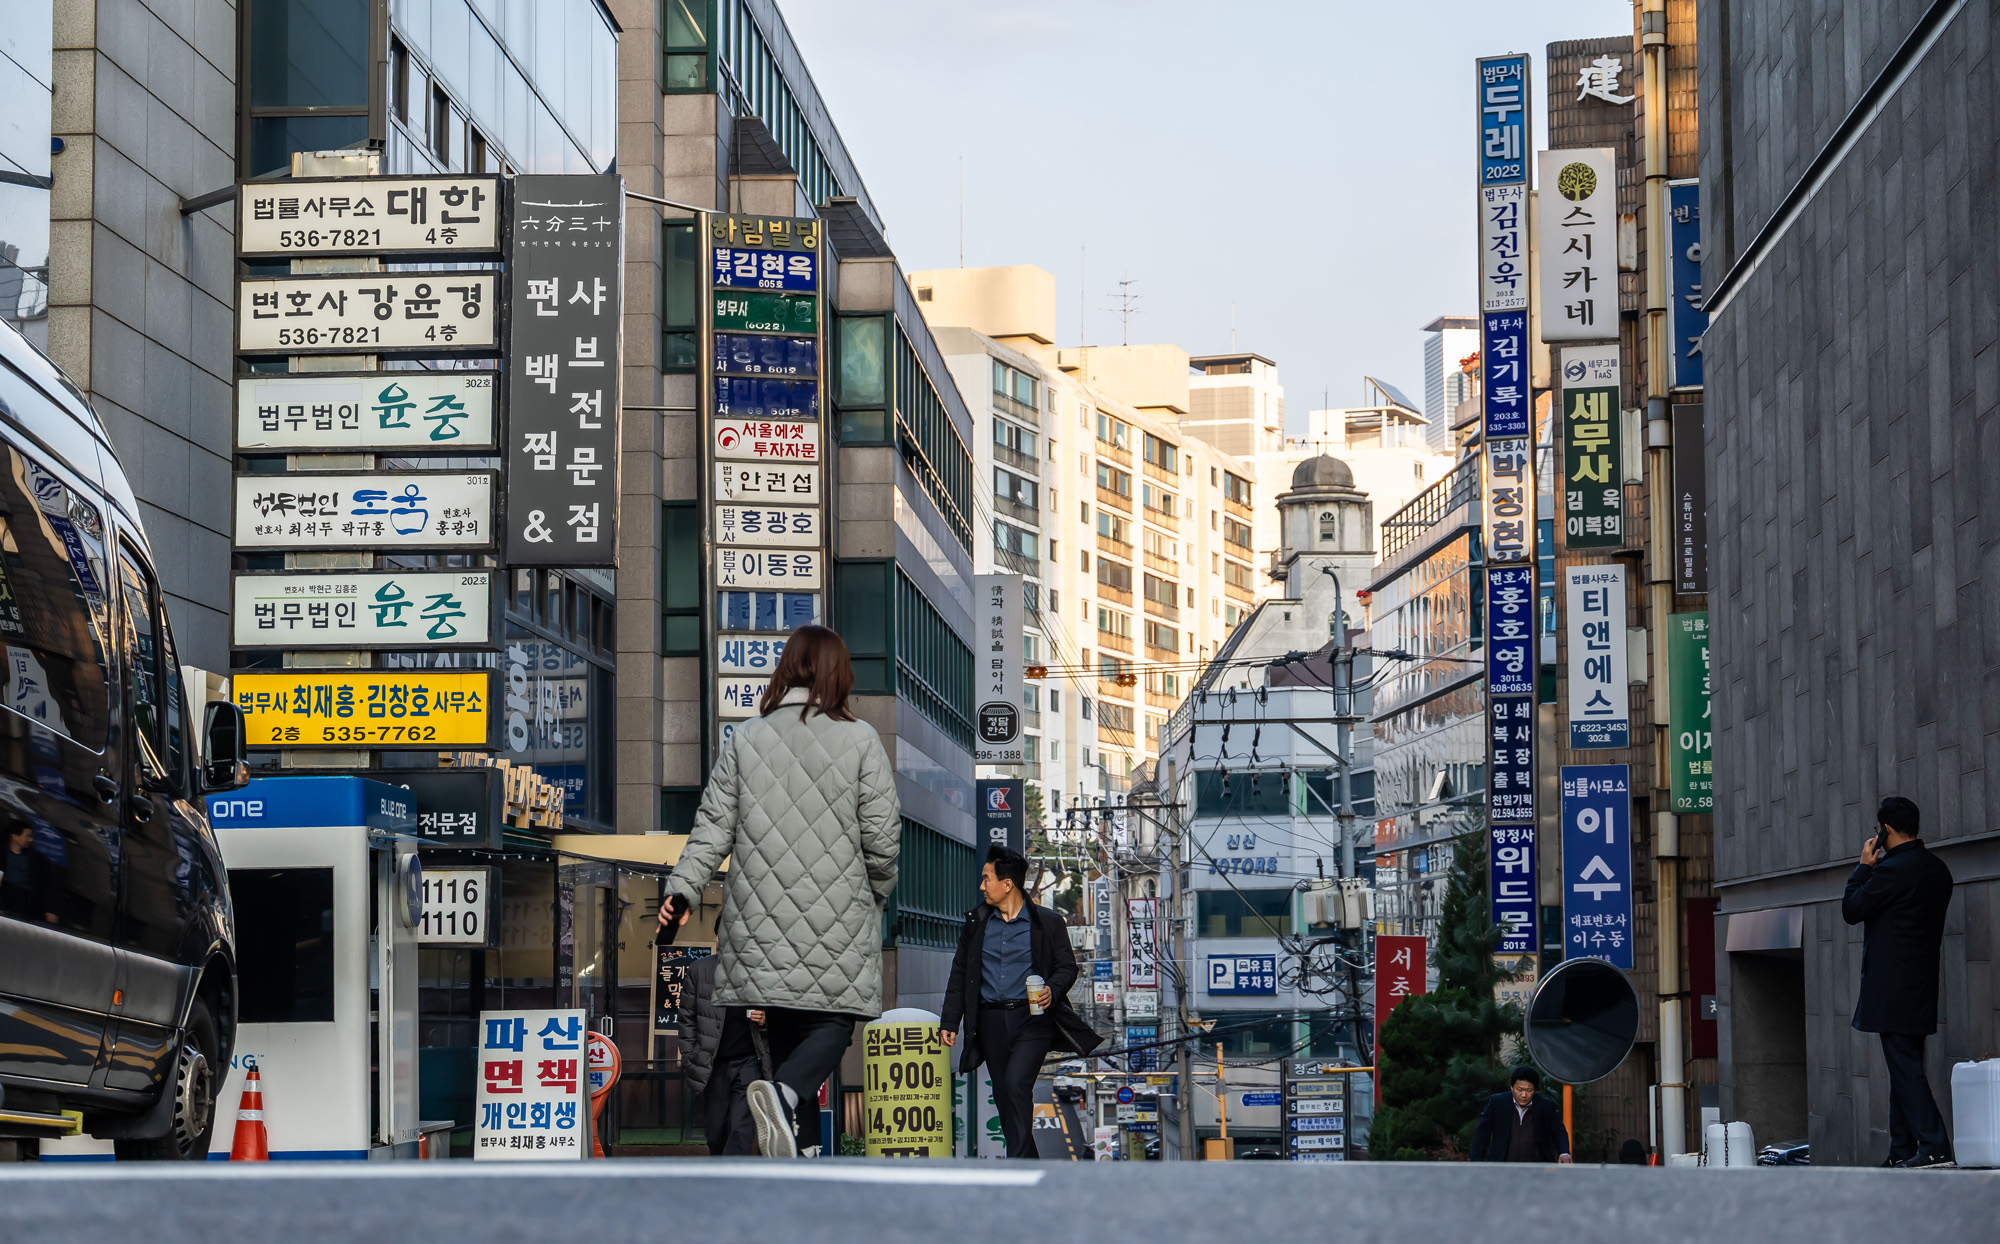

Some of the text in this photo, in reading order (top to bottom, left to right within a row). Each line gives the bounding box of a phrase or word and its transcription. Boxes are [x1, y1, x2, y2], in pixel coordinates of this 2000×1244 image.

[1483, 64, 1523, 84] 법무사
[1576, 53, 1635, 105] 建
[1484, 85, 1522, 160] 두레
[1486, 164, 1521, 179] 202호
[1485, 186, 1523, 202] 법무사
[254, 185, 486, 225] 법률사무소 대한
[520, 215, 611, 232] 六分三十
[280, 227, 459, 248] 536-7821 4층
[712, 217, 817, 249] 하림빌딩
[1489, 202, 1523, 289] 김진욱
[716, 249, 812, 286] 법무사 김현옥
[1561, 206, 1598, 326] 스시카네
[758, 280, 784, 289] 605호
[252, 283, 482, 321] 변호사 강윤경
[1486, 298, 1526, 308] 313-2577
[1496, 290, 1515, 298] 303호
[717, 300, 748, 317] 법무사
[1488, 317, 1524, 331] 법무사
[278, 324, 458, 345] 536-7821 4층
[768, 366, 797, 374] 601호
[1491, 335, 1523, 407] 김기록
[1588, 358, 1618, 368] 세무그룹
[465, 378, 491, 388] 302호
[258, 382, 469, 441] 법무법인 윤중
[1494, 411, 1520, 421] 203호
[742, 422, 804, 439] 서울에셋
[1489, 422, 1526, 432] 535-3303
[1490, 439, 1528, 453] 변호사
[1569, 391, 1613, 484] 세무사
[753, 441, 816, 458] 투자자문
[466, 475, 489, 486] 301호
[723, 466, 812, 498] 법무사 안권섭
[1492, 453, 1527, 551] 박정현
[1567, 488, 1620, 511] 김 욱
[253, 483, 429, 535] 법무법인 도움
[442, 508, 471, 518] 변호사
[1683, 492, 1693, 532] 스튜디오
[255, 523, 385, 537] 변호사 최석두 곽규홍
[436, 520, 478, 536] 홍광의
[722, 508, 812, 542] 법무사 홍광호
[1567, 515, 1620, 536] 이복희
[723, 551, 813, 584] 법무사 이동윤
[461, 576, 488, 586] 202호
[1490, 570, 1531, 586] 변호사
[1572, 574, 1620, 585] 법률사무소
[284, 585, 305, 594] 변호사
[308, 584, 332, 595] 박현근
[254, 580, 467, 640] 법무법인 윤중
[1491, 587, 1530, 673] 홍호영
[1581, 587, 1614, 715] 티앤에스
[991, 658, 1004, 695] 담아서
[1500, 675, 1523, 683] 301호
[1490, 683, 1532, 693] 508-0635
[239, 691, 288, 715] 법무사
[433, 690, 482, 714] 사무소
[1493, 702, 1530, 719] 인쇄
[271, 726, 436, 741] 2층 535-7762
[1493, 725, 1531, 743] 복사
[1572, 723, 1627, 733] T.6223-3453
[1588, 734, 1612, 742] 302호
[975, 750, 1021, 760] 595-1388
[1493, 748, 1531, 766] 도장
[1564, 777, 1627, 798] 법률사무소
[1492, 794, 1532, 806] 천일기획
[1492, 807, 1533, 818] 02.594.3555
[419, 812, 477, 835] 전문점
[1226, 834, 1256, 850] 신신
[1492, 829, 1535, 843] 행정사
[1573, 806, 1621, 901] 이수
[1209, 857, 1278, 875] MOTORS
[1495, 847, 1533, 938] 위드문
[1570, 913, 1627, 927] 대표변호사
[1503, 941, 1527, 950] 501호
[1573, 930, 1625, 948] 이수동
[1250, 959, 1273, 972] 유료
[1238, 975, 1274, 989] 주차장
[484, 1016, 583, 1052] 파산
[866, 1026, 942, 1057] 점심특선
[484, 1059, 577, 1094] 면책
[867, 1061, 943, 1093] 11,900원
[481, 1101, 576, 1130] 개인회생
[868, 1106, 943, 1135] 14,900원
[480, 1135, 576, 1149] 법무사 최재홍 사무소
